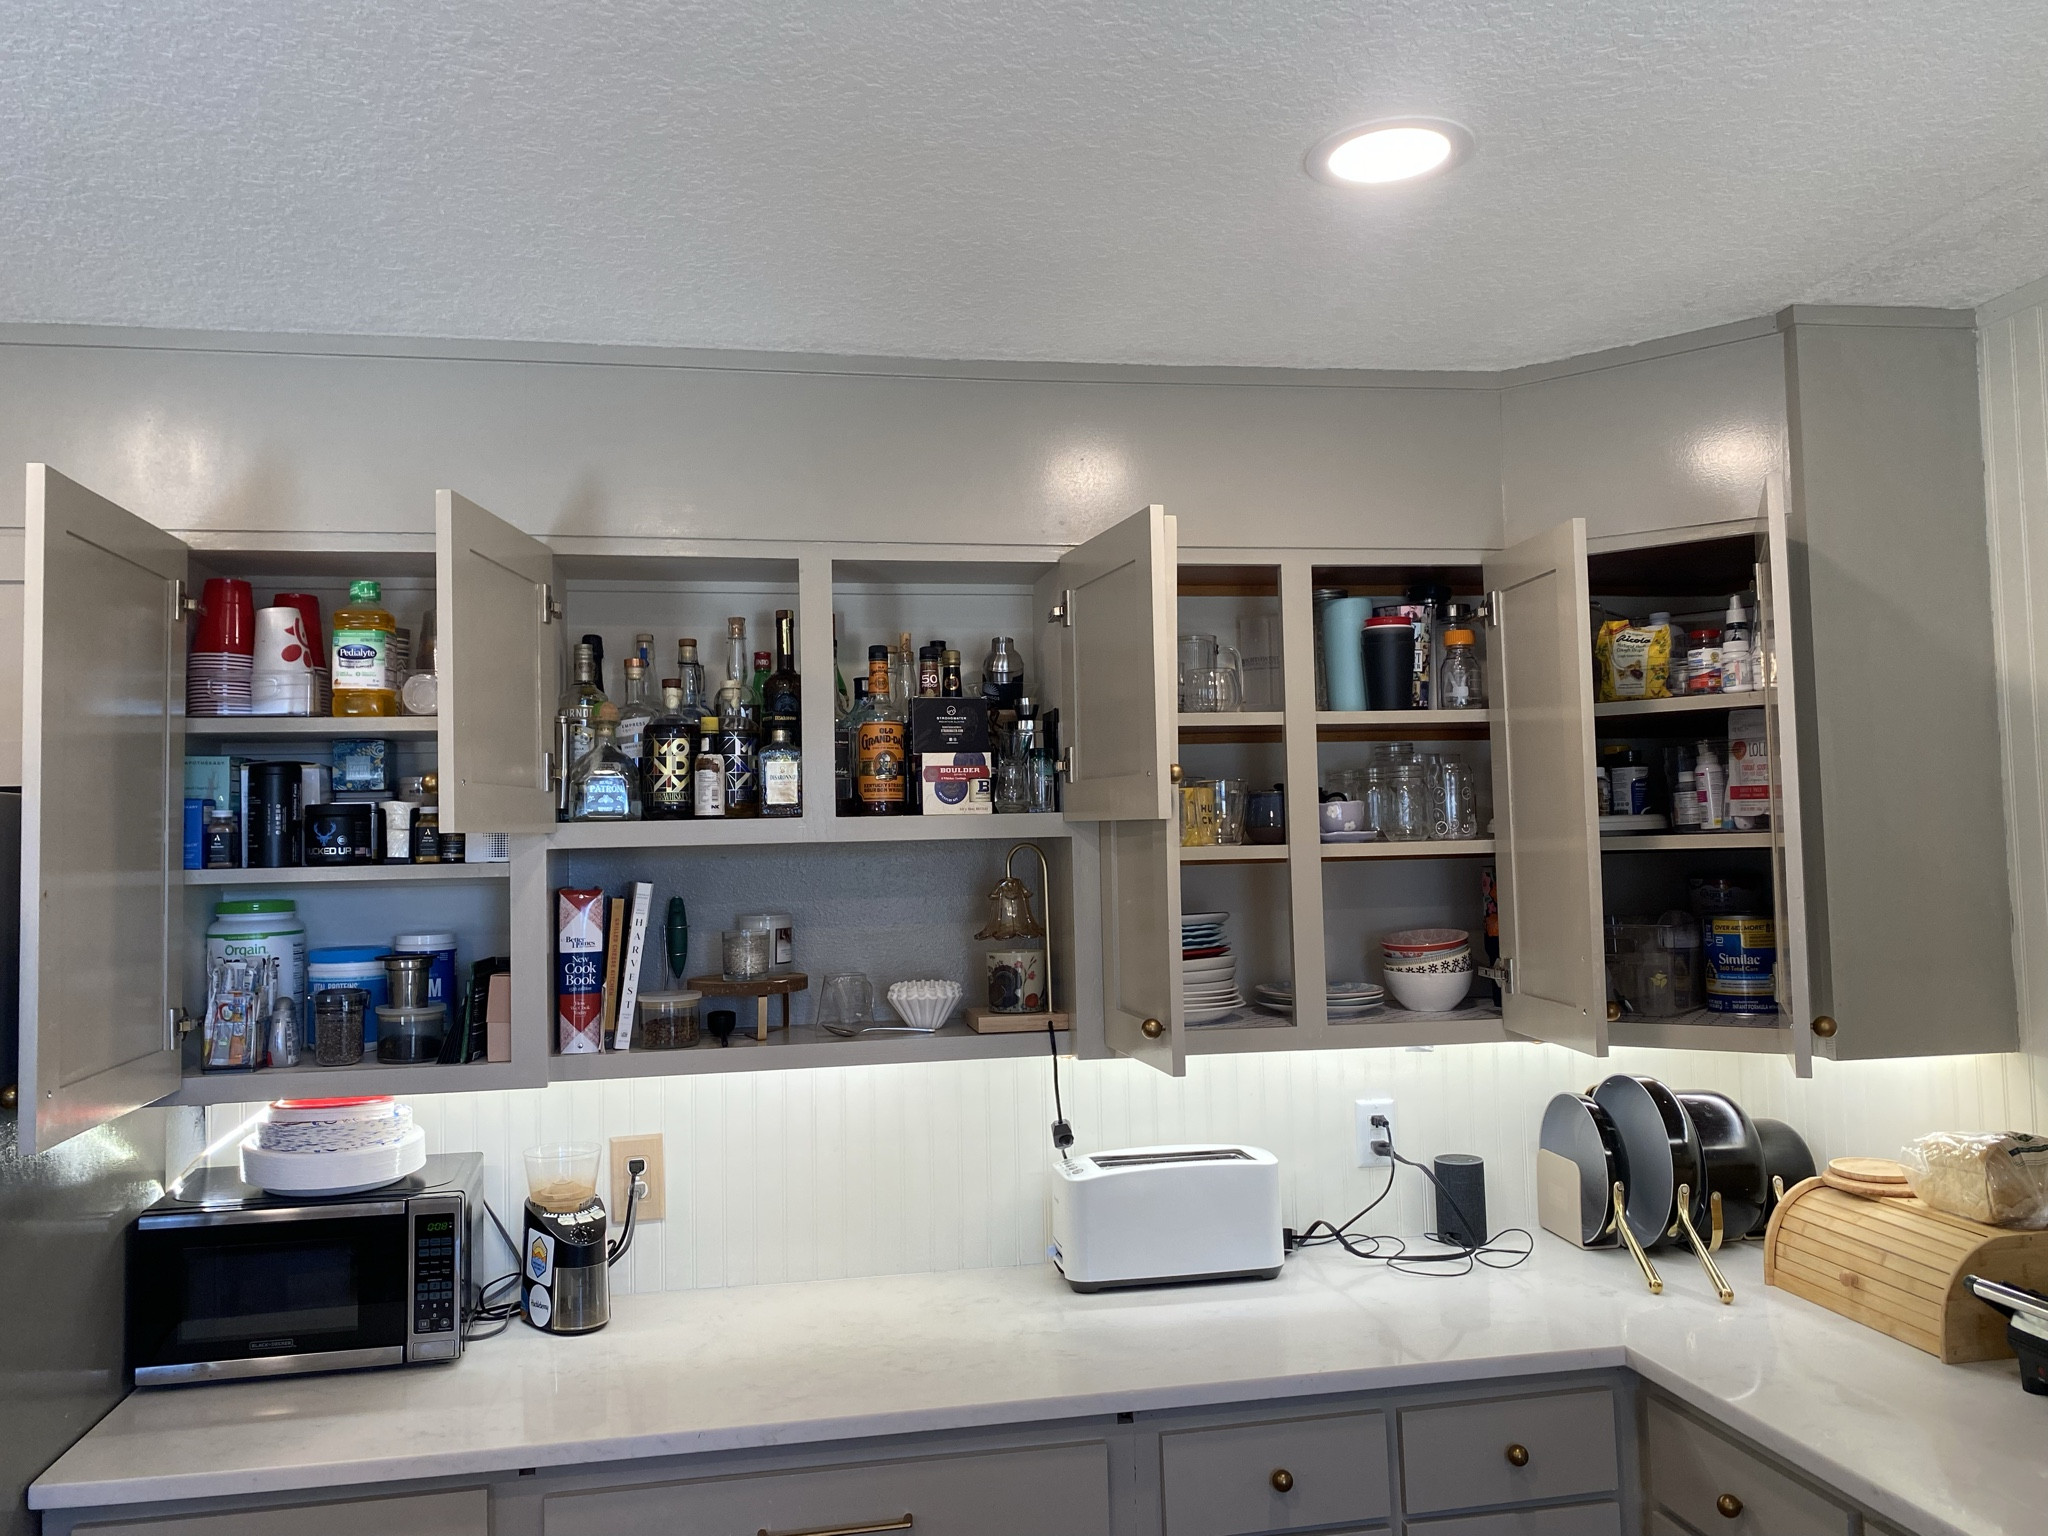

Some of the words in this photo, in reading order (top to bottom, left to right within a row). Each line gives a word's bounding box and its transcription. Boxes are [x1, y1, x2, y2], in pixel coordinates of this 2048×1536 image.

[1616, 634, 1651, 644] Ricola
[340, 648, 376, 658] Pedialyte
[922, 674, 938, 684] 50
[978, 780, 990, 792] B
[1201, 804, 1212, 813] HU
[1202, 816, 1213, 824] CK
[338, 846, 352, 854] UP
[572, 940, 596, 949] Homes
[225, 944, 266, 956] Orgain
[625, 918, 642, 1009] HARVEST
[1719, 953, 1760, 965] Similac
[565, 962, 596, 974] Cook
[566, 974, 596, 986] Book
